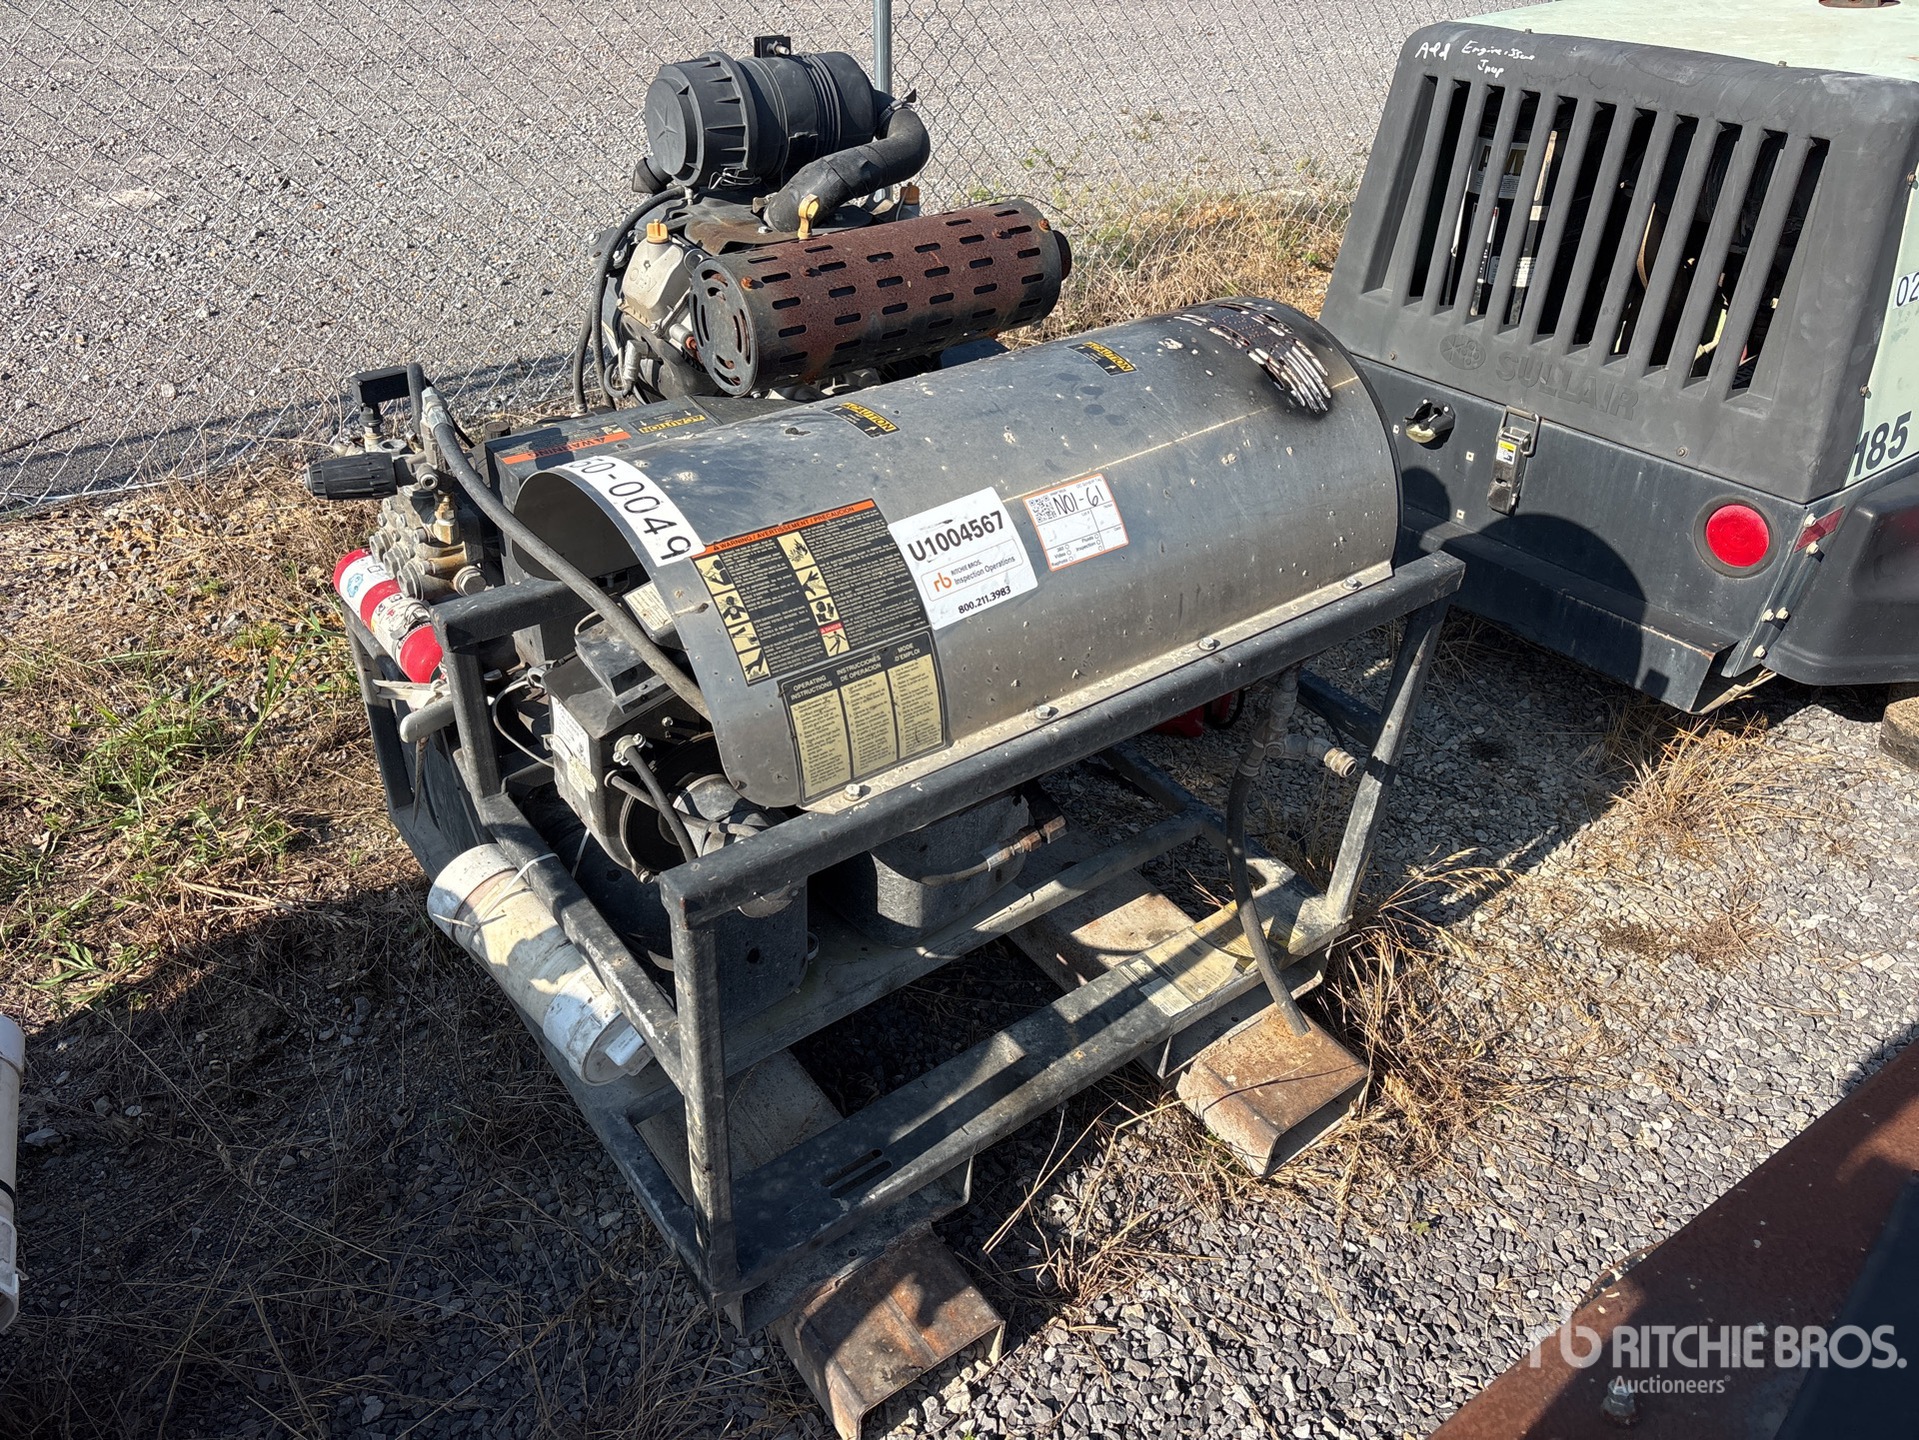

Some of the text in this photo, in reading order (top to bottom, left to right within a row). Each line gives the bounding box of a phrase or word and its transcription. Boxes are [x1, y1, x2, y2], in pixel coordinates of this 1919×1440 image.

[1496, 351, 1639, 421] SULLAIR
[1853, 411, 1912, 477] 185
[720, 534, 753, 549] WARNING
[757, 519, 810, 539] AVERTISSEMENT
[908, 510, 1004, 562] U1004567
[954, 556, 1016, 585] Inspection Operations
[958, 585, 1011, 614] 800.211.3983
[897, 643, 914, 653] MODE
[791, 681, 833, 700] INSTRUCTIONS
[793, 675, 827, 691] OPERATING
